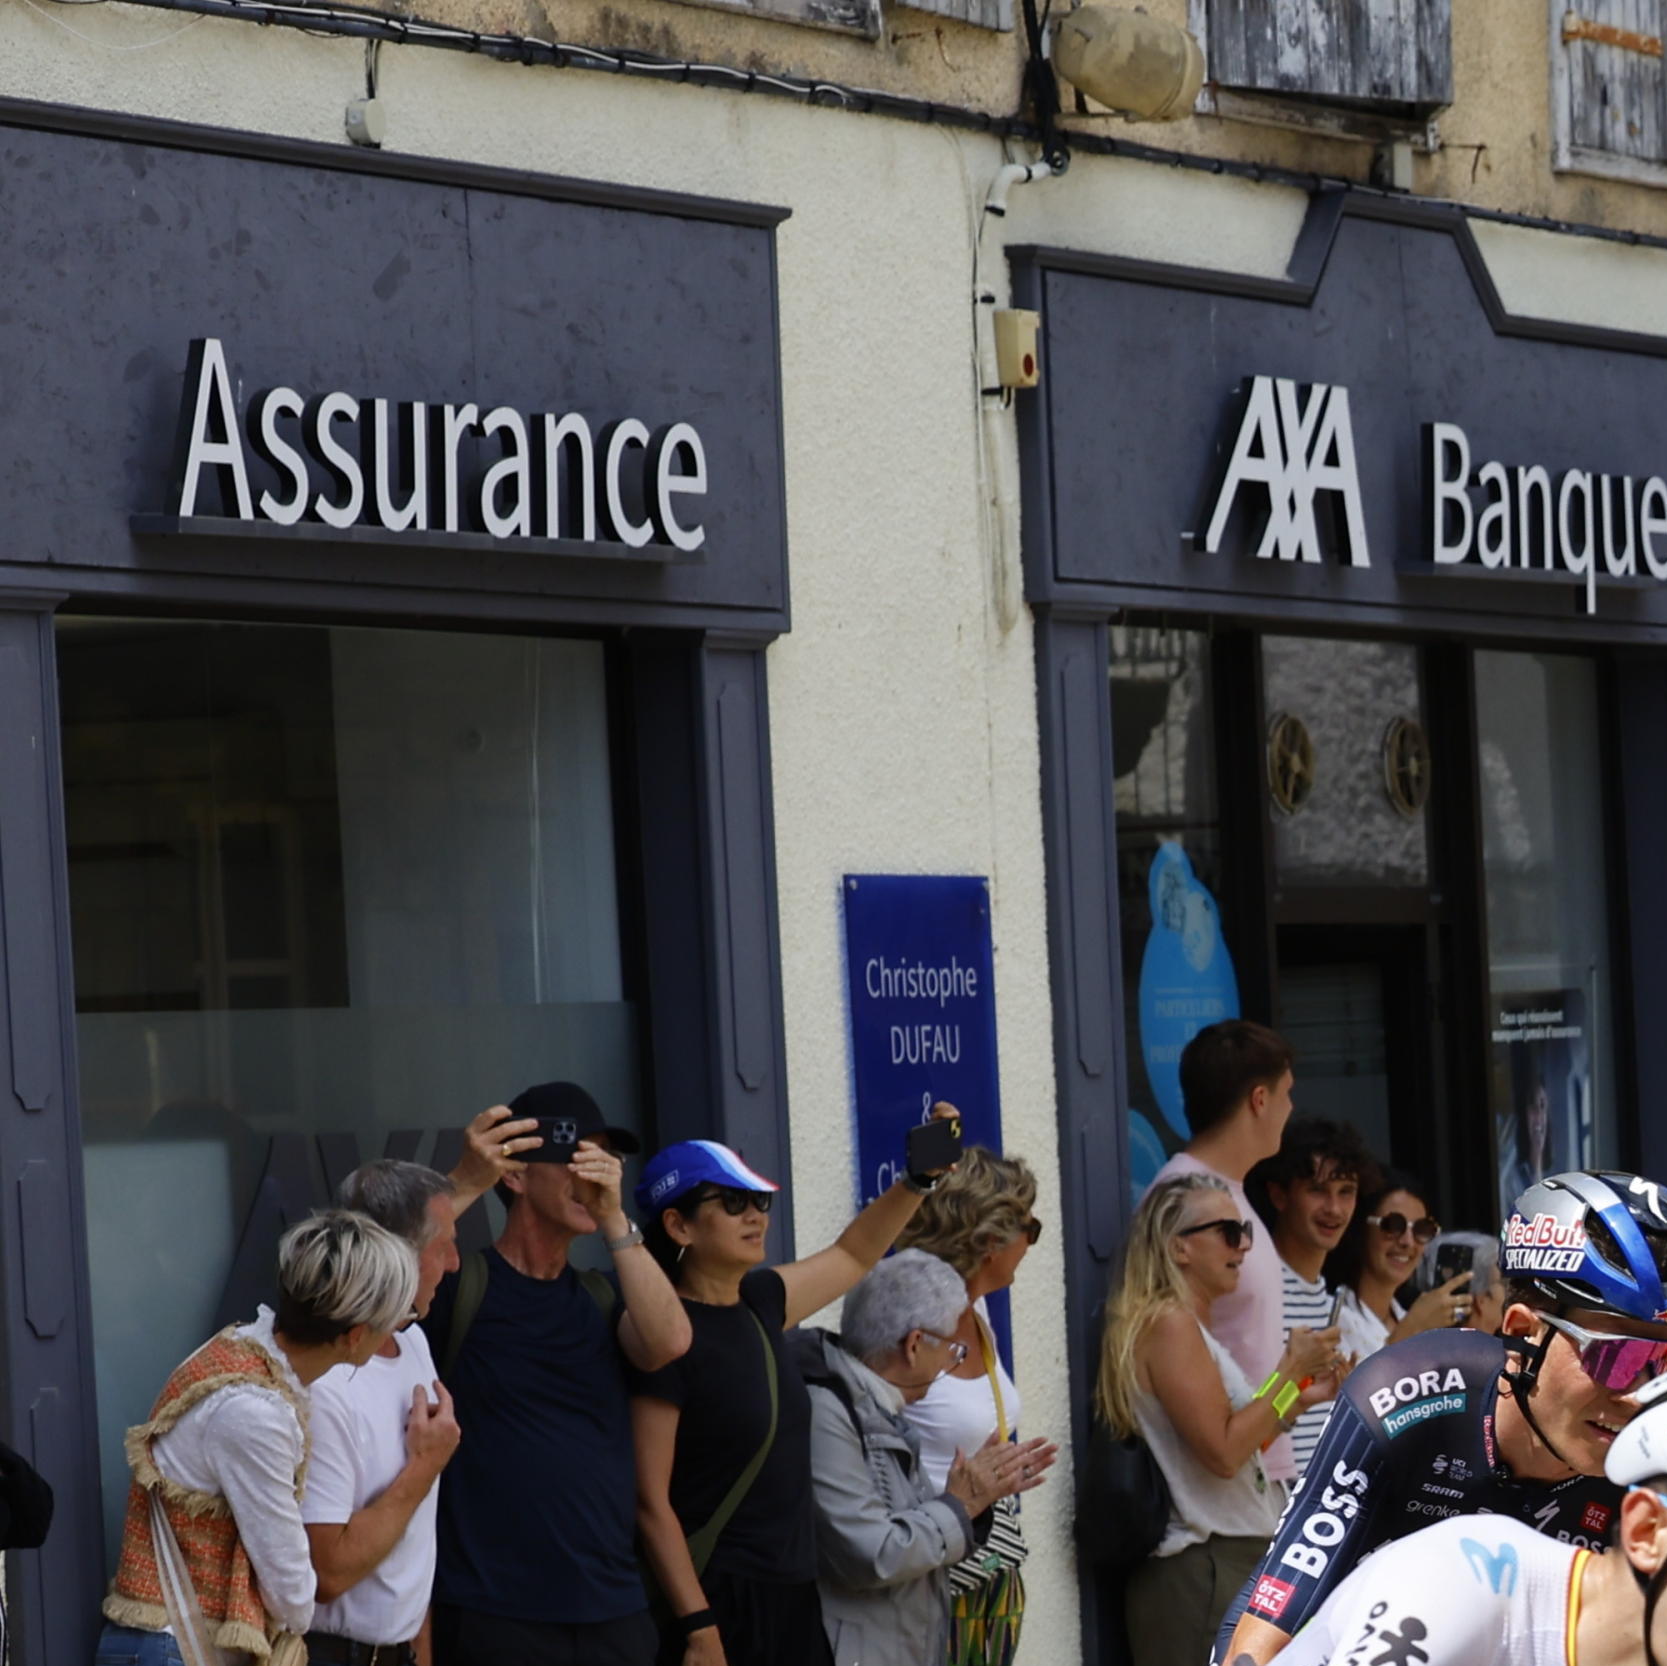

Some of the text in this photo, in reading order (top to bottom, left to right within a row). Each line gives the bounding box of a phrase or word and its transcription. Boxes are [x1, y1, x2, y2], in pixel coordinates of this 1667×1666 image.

[180, 338, 708, 552] Assurance
[1206, 374, 1371, 568] AXA
[866, 956, 978, 1007] Christophe
[890, 1024, 961, 1065] DUFAU
[1505, 1248, 1586, 1273] SPECIALIZED
[1368, 1367, 1467, 1419] BORA
[1383, 1396, 1464, 1435] hansgrohe
[1281, 1460, 1369, 1580] BOSS
